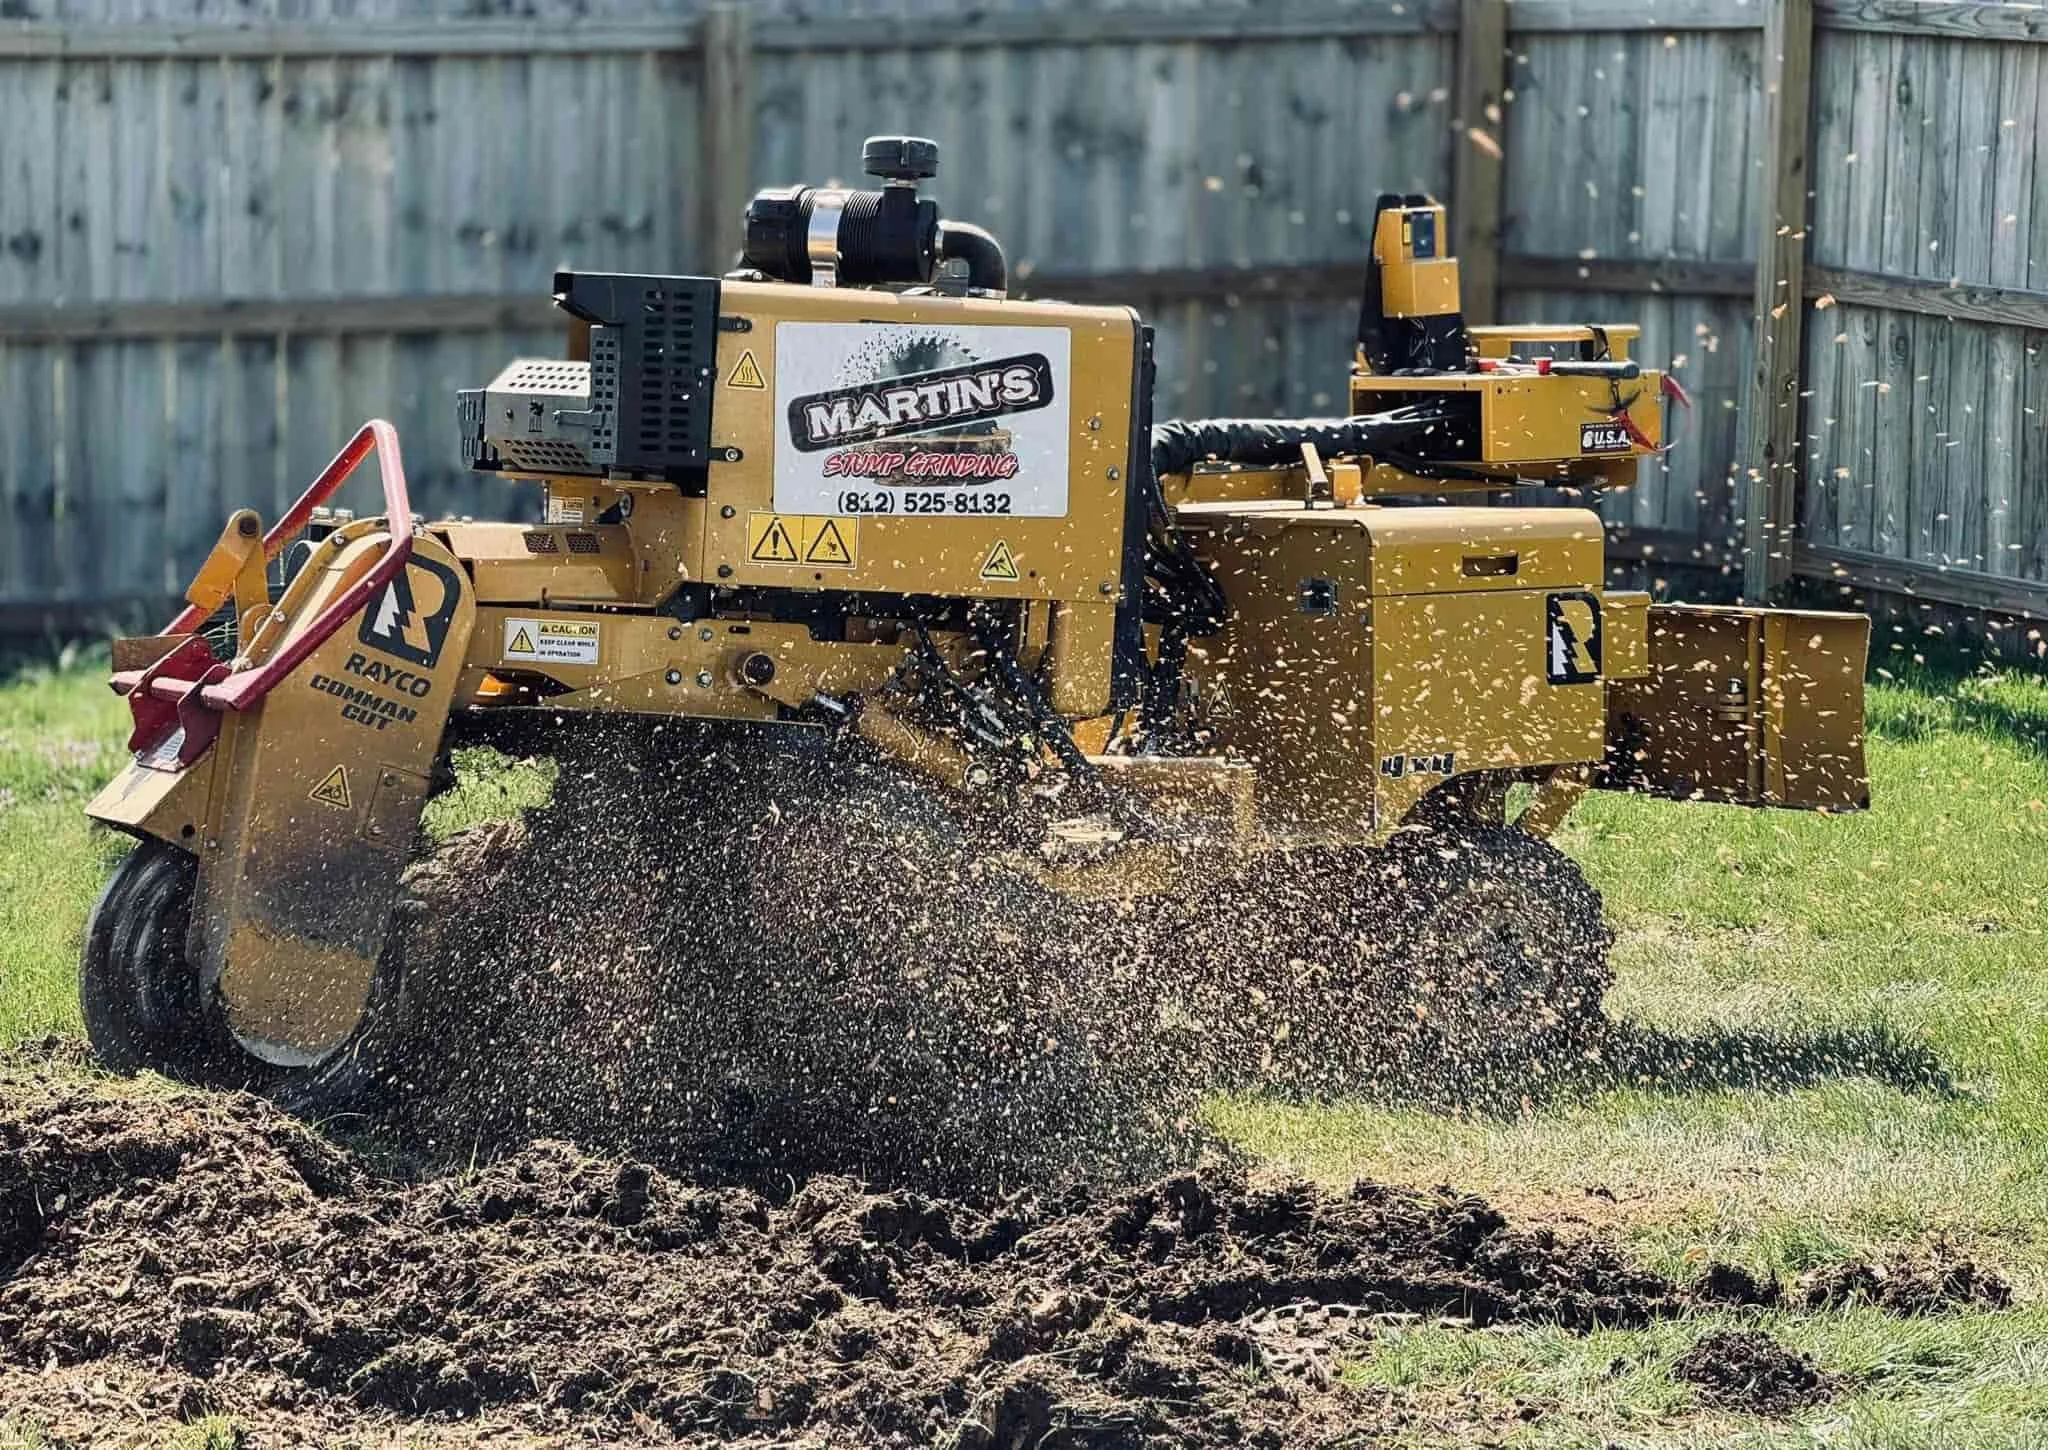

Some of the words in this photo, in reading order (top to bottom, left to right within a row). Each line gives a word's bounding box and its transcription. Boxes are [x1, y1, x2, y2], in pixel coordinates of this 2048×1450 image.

[805, 366, 1040, 441] MARTIN'S
[824, 451, 904, 477] STUMP
[903, 453, 1020, 479] GRINDING
[838, 491, 895, 513] (812)
[904, 491, 1011, 513] 525-8132
[344, 652, 431, 698] RAYCO
[342, 703, 393, 730] CUT
